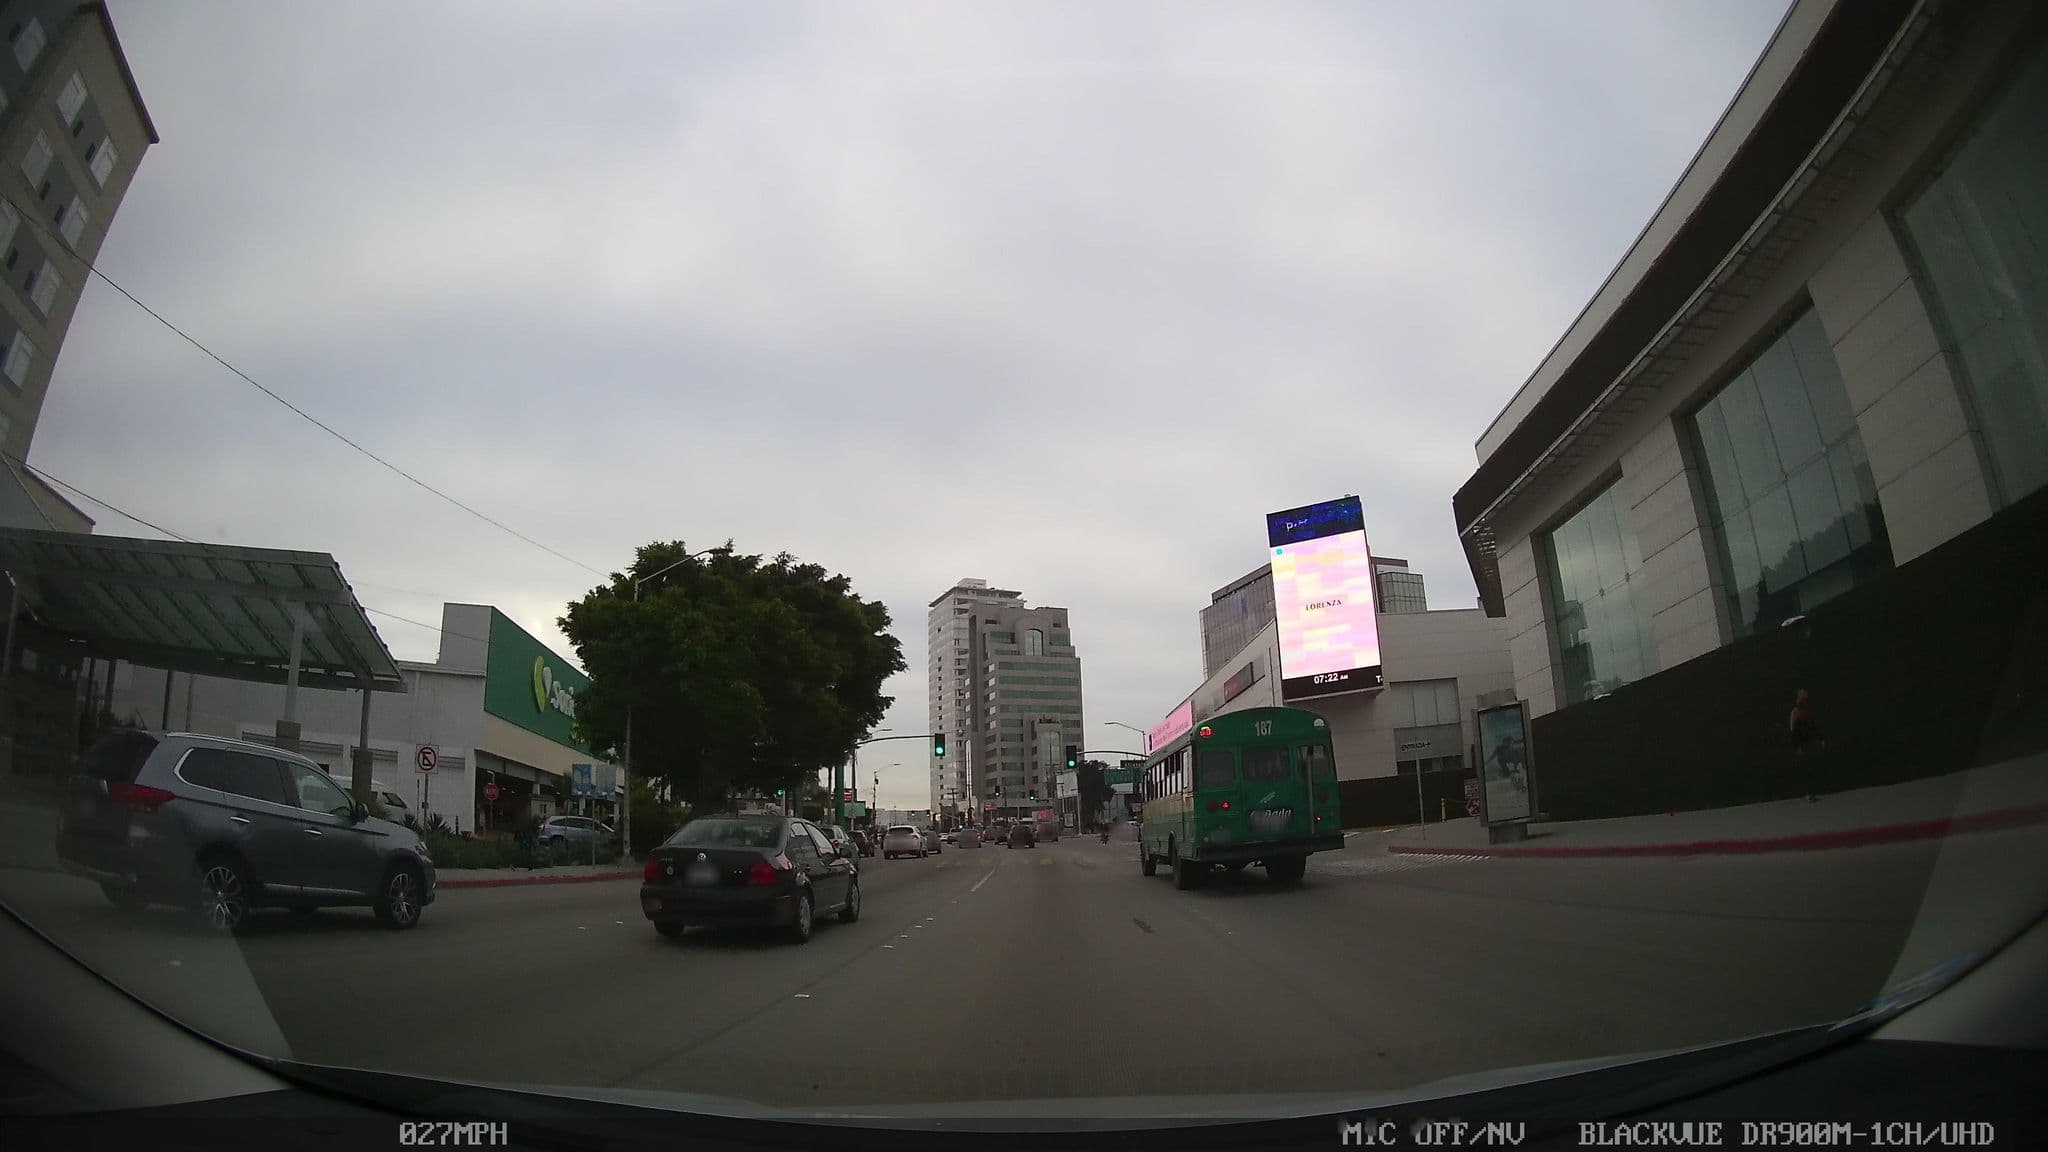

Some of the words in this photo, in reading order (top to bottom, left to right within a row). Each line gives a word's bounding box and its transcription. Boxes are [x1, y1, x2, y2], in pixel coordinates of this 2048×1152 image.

[1305, 600, 1343, 611] LORENZA
[1313, 673, 1339, 684] 07:22
[1254, 720, 1273, 737] 187
